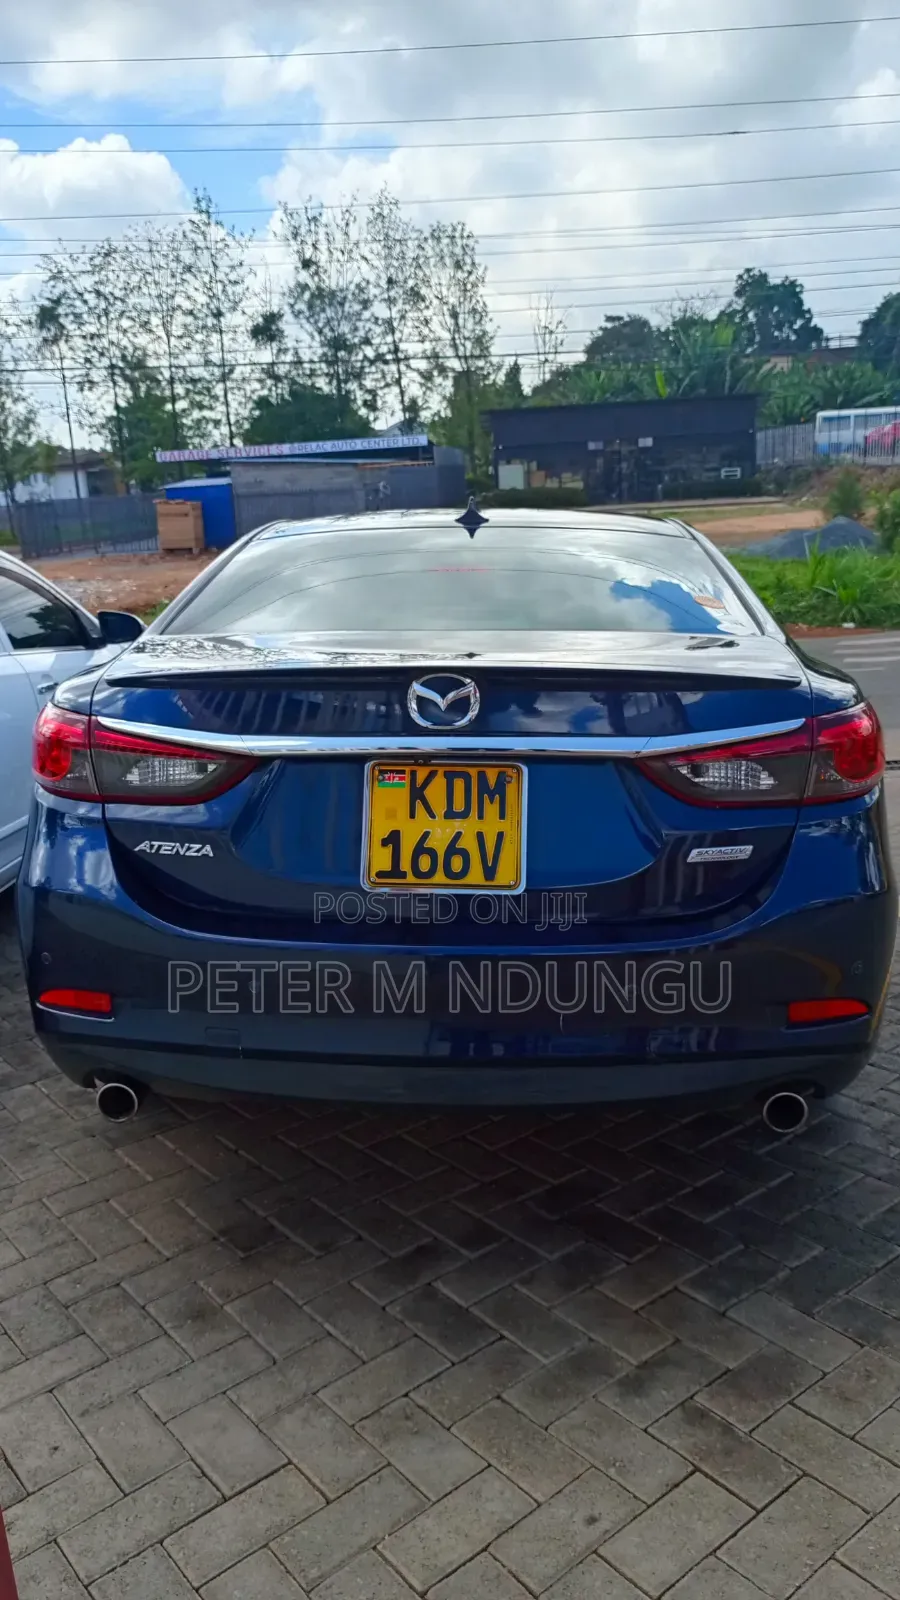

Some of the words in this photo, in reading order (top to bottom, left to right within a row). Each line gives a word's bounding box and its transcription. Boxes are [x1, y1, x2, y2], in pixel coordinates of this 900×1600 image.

[330, 440, 358, 451] AUTO
[360, 438, 399, 449] CENTER
[408, 769, 507, 820] KDM
[133, 840, 214, 857] ATENZA
[374, 829, 505, 882] 166V
[695, 847, 747, 856] SKYACTIV
